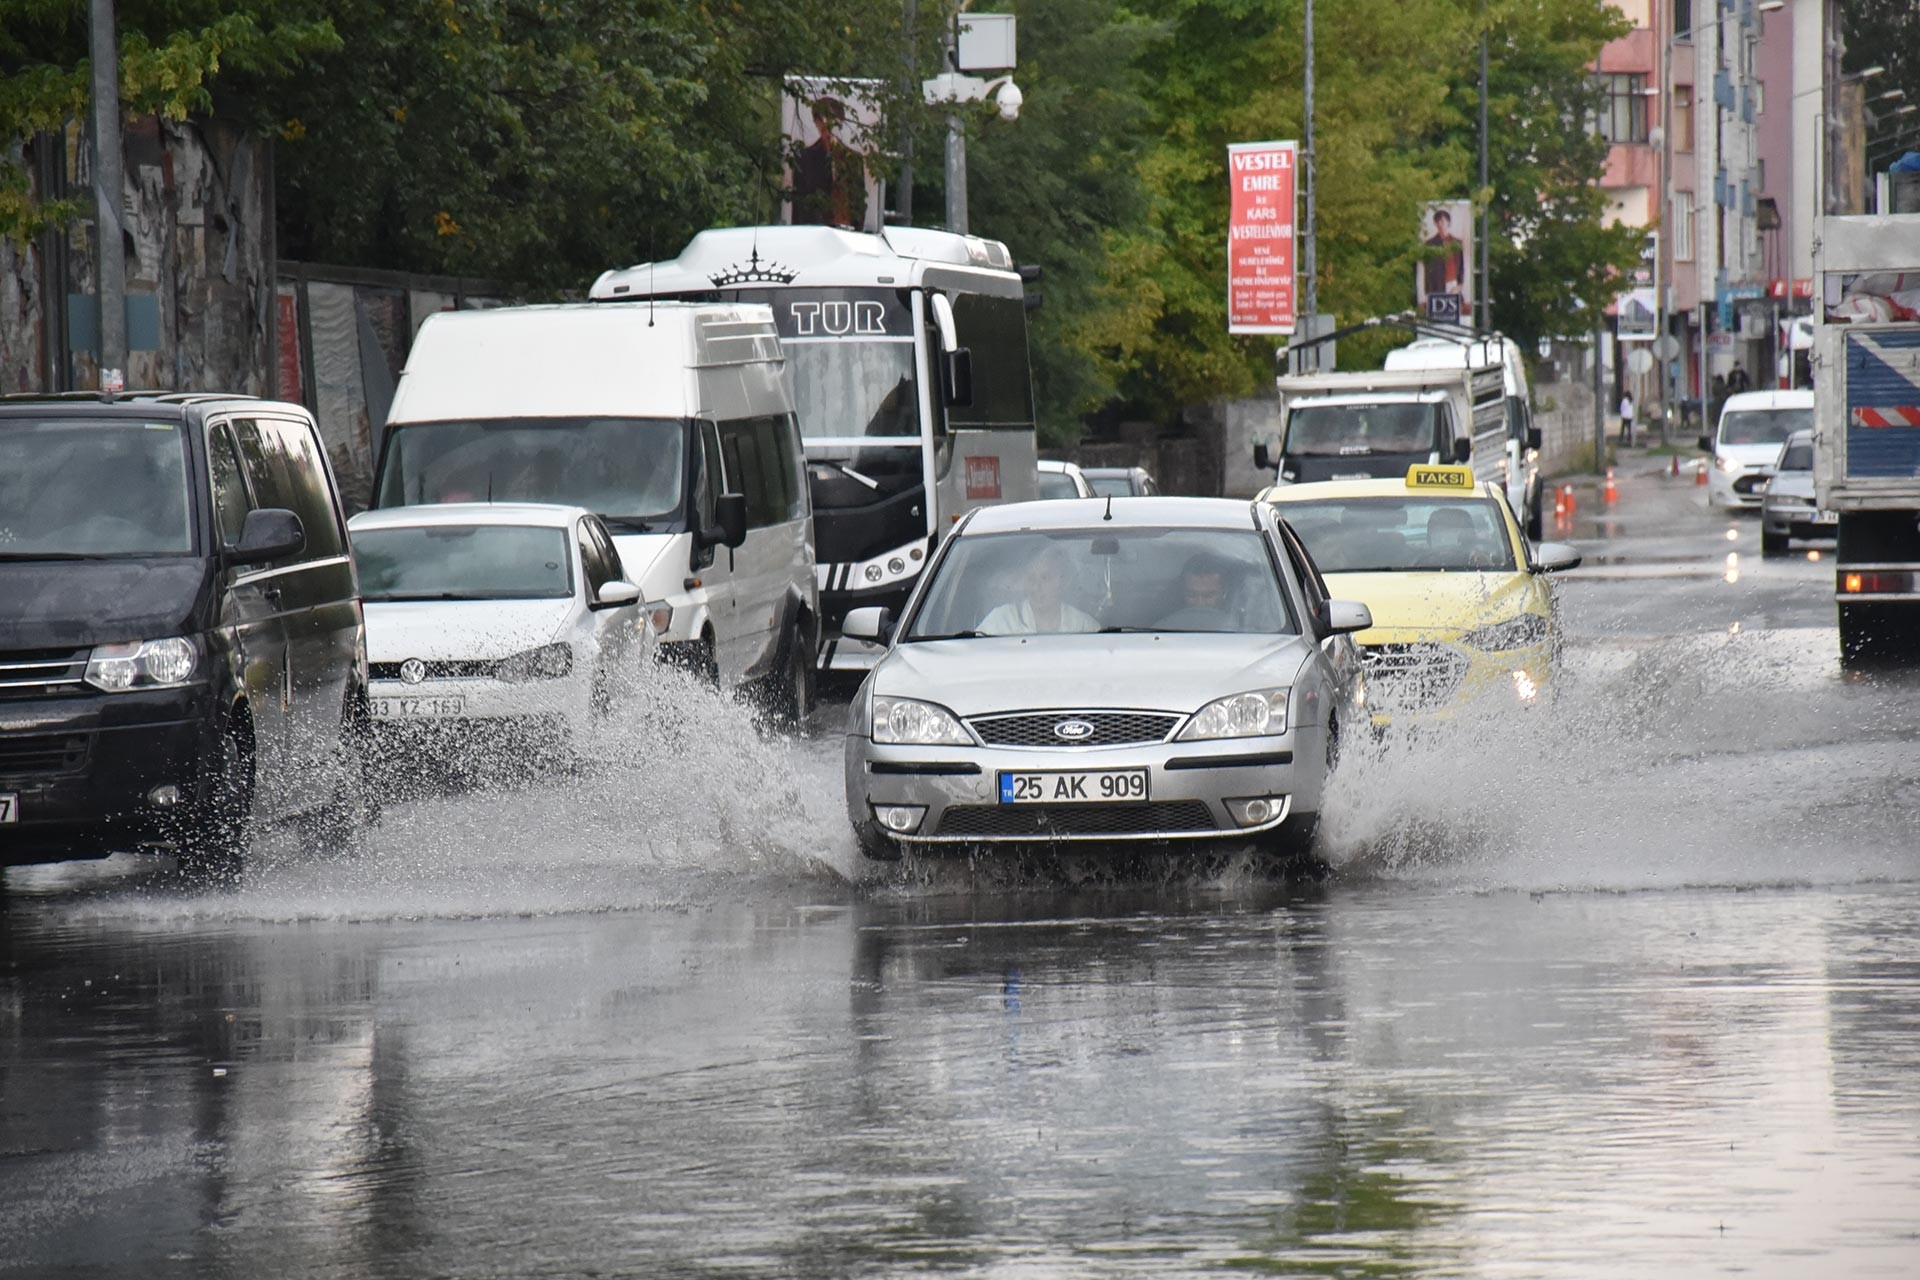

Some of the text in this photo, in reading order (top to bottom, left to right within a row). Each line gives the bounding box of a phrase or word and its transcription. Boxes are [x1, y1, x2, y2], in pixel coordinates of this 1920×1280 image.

[1234, 152, 1291, 171] VESTEL
[1243, 174, 1281, 192] EMRE
[1247, 207, 1277, 220] KARS
[791, 301, 886, 335] TUR
[1062, 724, 1085, 735] Ford
[1003, 774, 1144, 799] TR 25 AK 909
